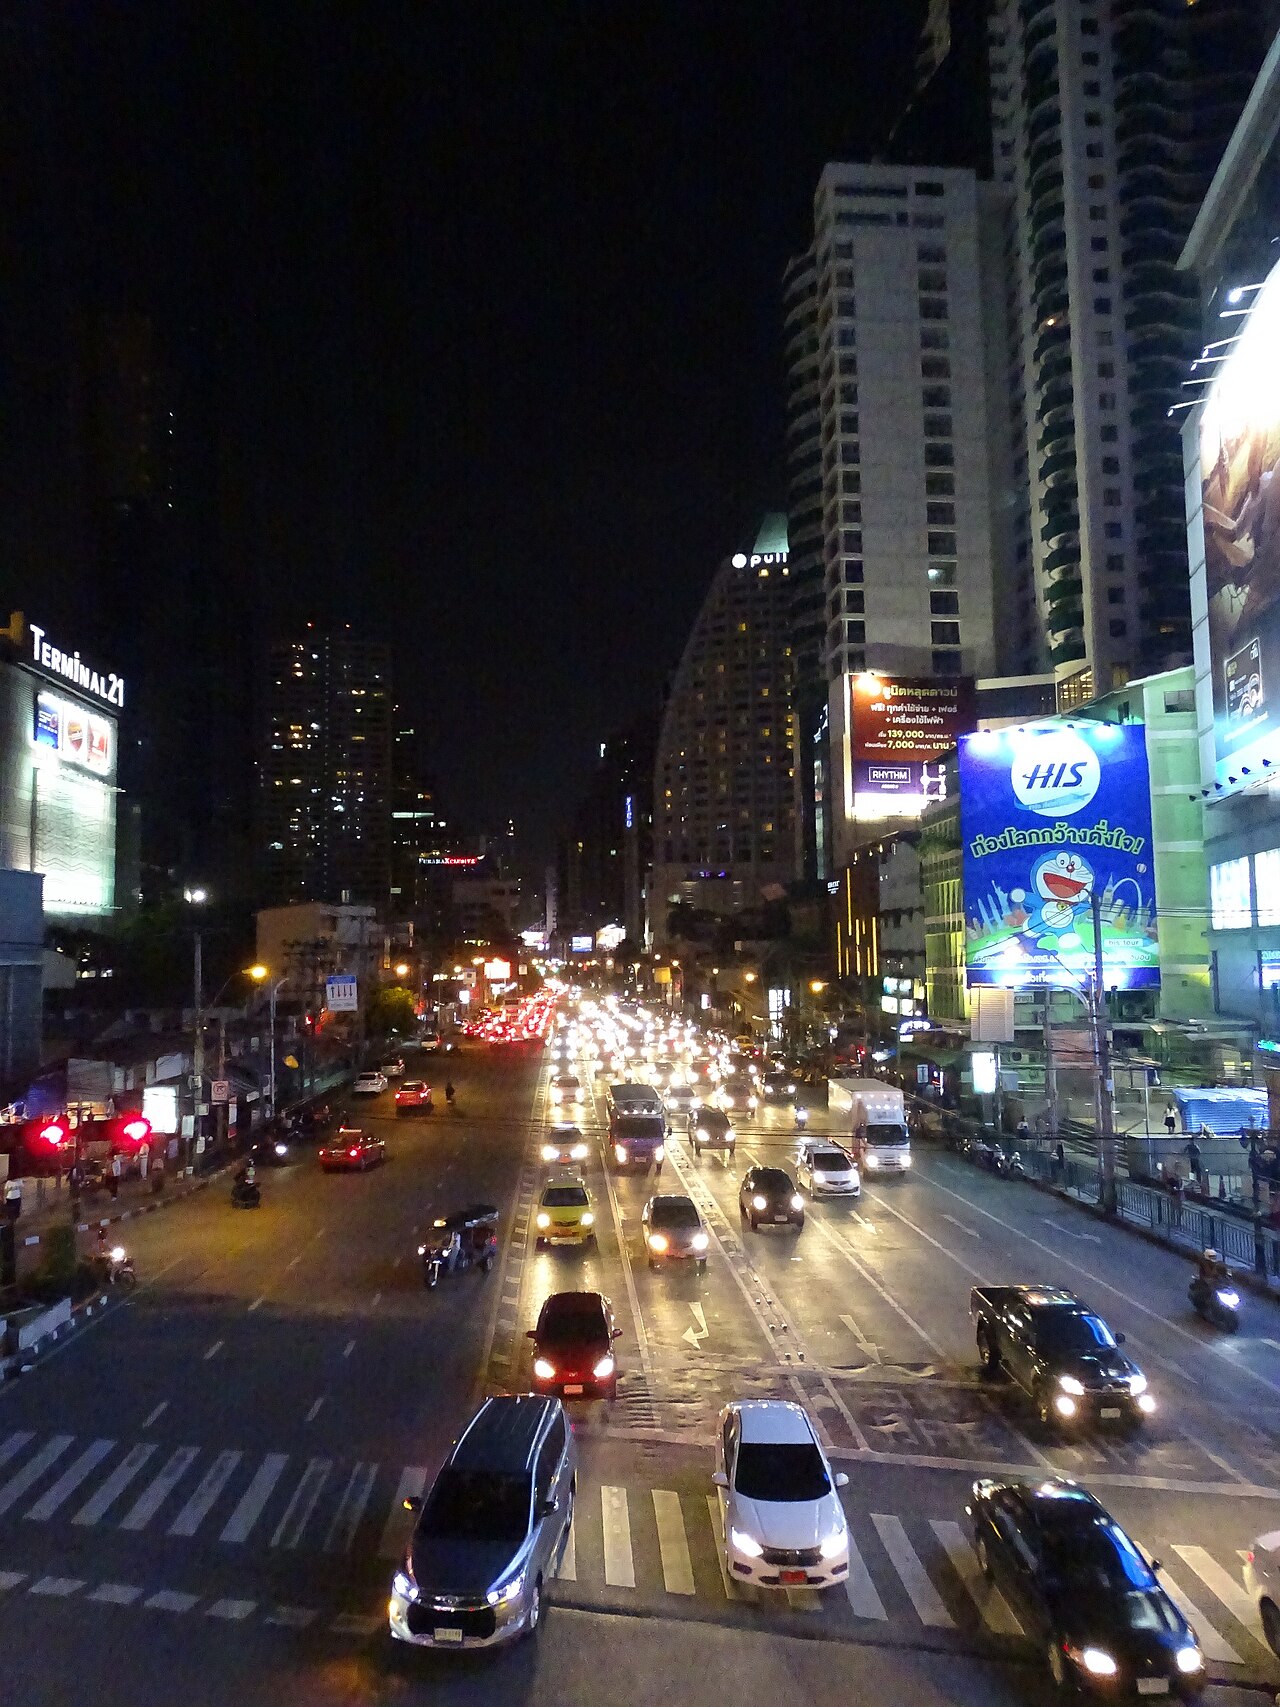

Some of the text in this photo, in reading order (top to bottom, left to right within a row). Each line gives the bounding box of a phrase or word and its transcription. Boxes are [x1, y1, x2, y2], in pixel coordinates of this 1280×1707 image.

[887, 729, 924, 740] 139,000
[887, 740, 915, 750] 7,000
[872, 770, 907, 780] RHYTHM
[970, 820, 1145, 858] ท่องโลกกว้างดั่งใจ!
